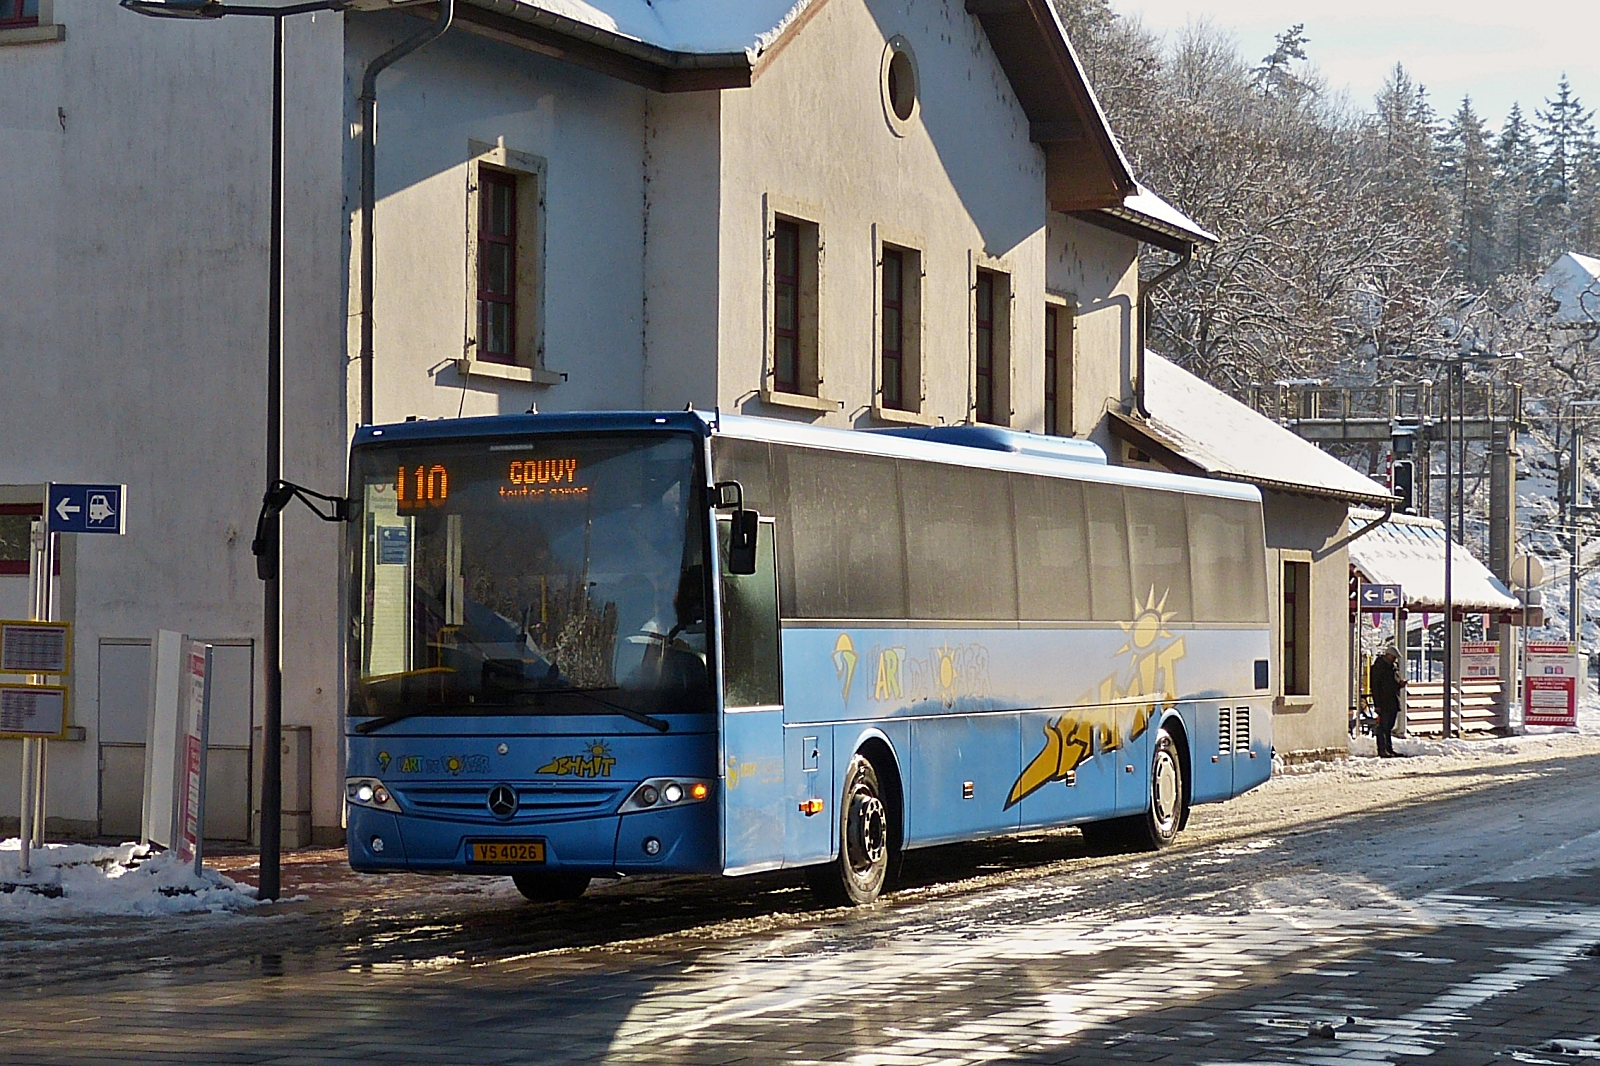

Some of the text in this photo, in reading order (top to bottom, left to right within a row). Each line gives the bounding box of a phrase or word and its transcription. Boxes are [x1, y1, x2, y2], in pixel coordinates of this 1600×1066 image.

[510, 459, 577, 485] GOUVY
[397, 464, 448, 508] L10
[480, 845, 497, 859] VS
[501, 845, 537, 860] 4026
